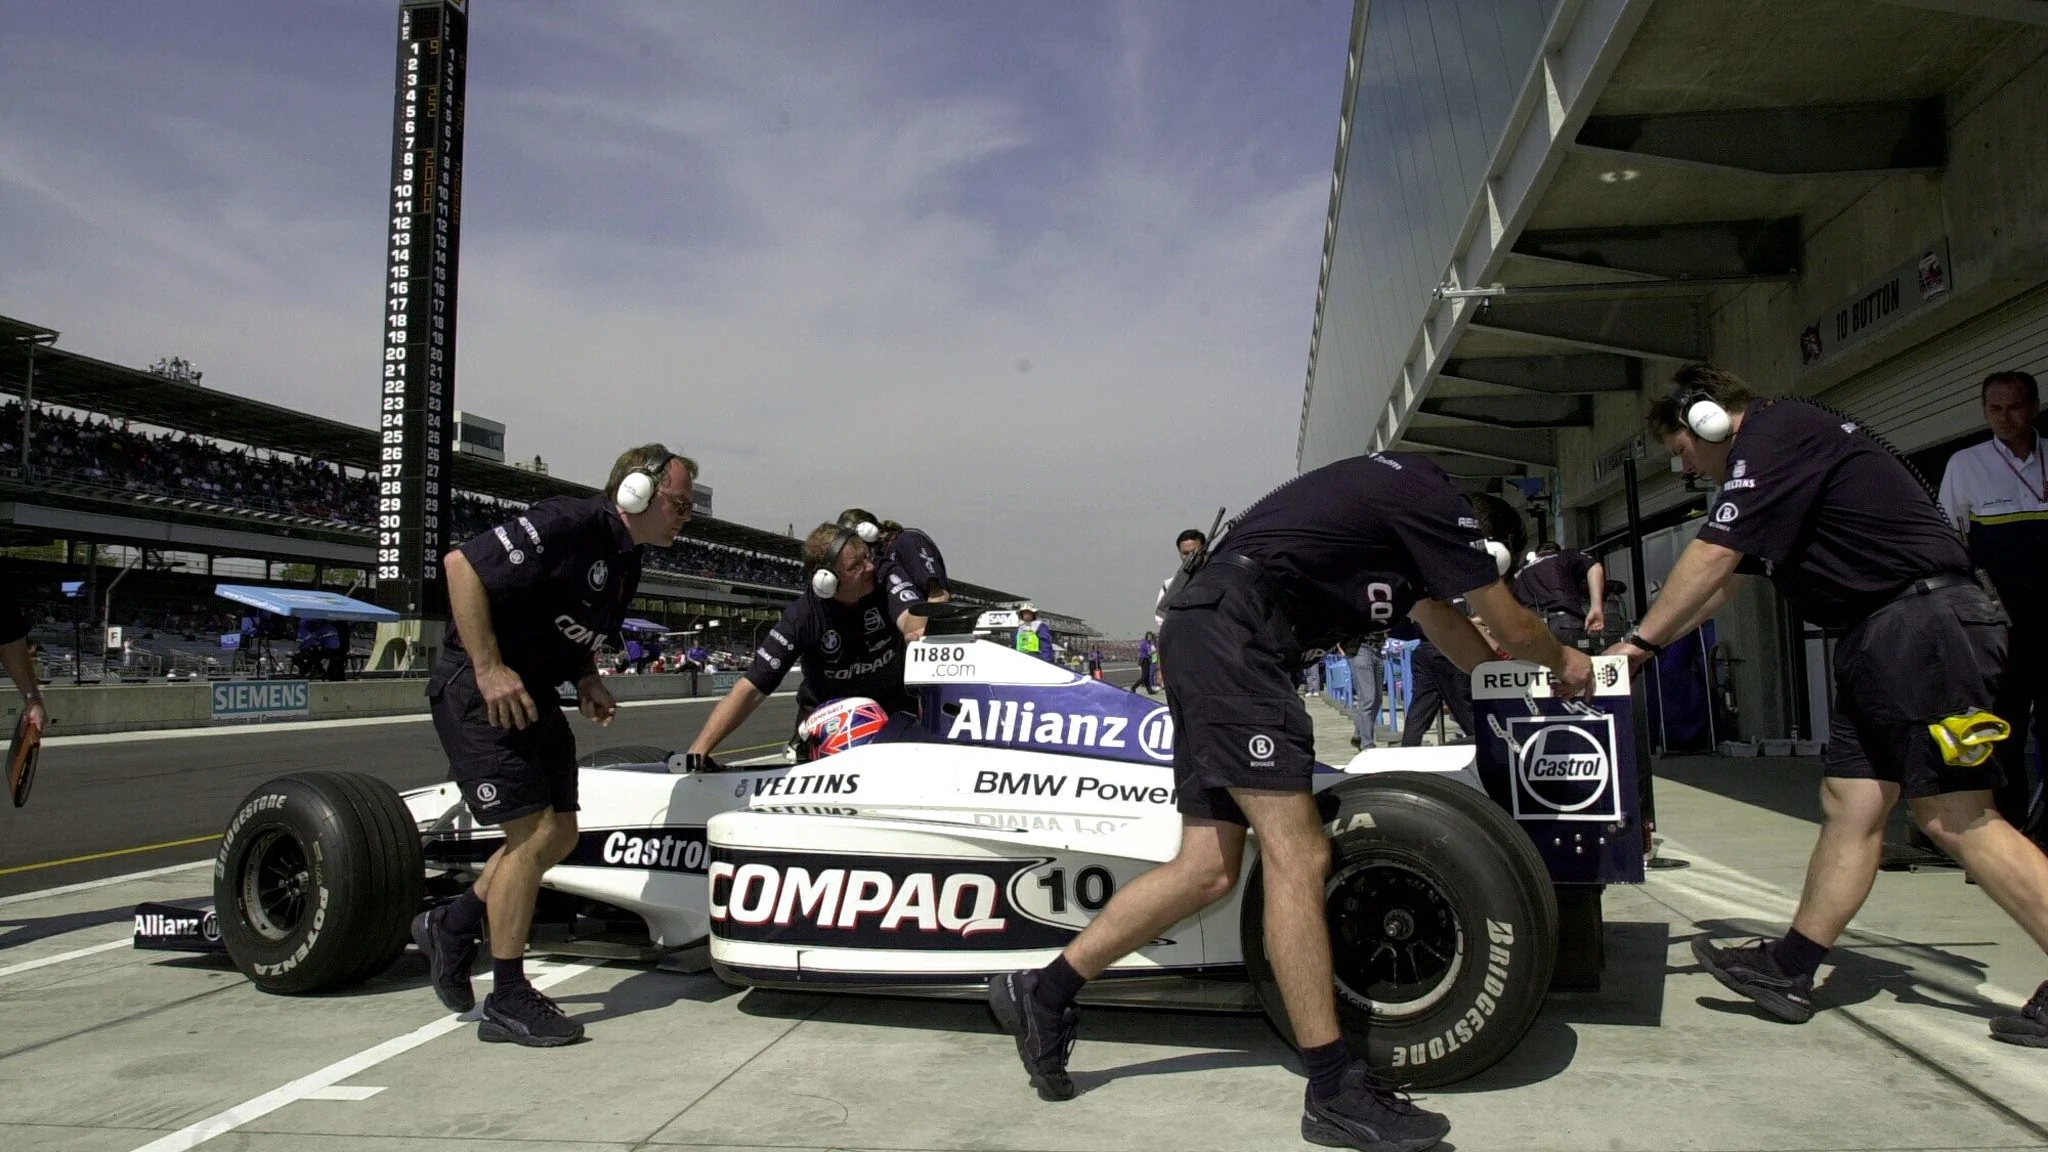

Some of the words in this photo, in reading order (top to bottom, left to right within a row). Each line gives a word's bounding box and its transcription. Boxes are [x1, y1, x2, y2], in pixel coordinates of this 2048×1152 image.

[410, 42, 419, 55] 1
[408, 58, 417, 70] 2
[408, 74, 417, 85] 3
[406, 90, 416, 101] 4
[406, 106, 415, 117] 5
[405, 121, 415, 133] 6
[405, 137, 414, 149] 7
[404, 153, 413, 165] 8
[404, 169, 413, 181] 9
[395, 185, 412, 197] 10
[395, 201, 411, 213] 11
[393, 217, 410, 229] 12
[392, 233, 410, 245] 13
[392, 249, 409, 261] 14
[391, 265, 408, 278] 15
[390, 282, 408, 294] 16
[390, 298, 407, 310] 17
[1836, 309, 1848, 342] 10
[1852, 277, 1900, 333] BUTTON
[389, 314, 407, 327] 18
[388, 331, 406, 343] 19
[386, 347, 405, 360] 20
[385, 364, 405, 377] 21
[385, 380, 404, 393] 22
[384, 397, 403, 410] 23
[383, 414, 403, 427] 24
[383, 431, 402, 443] 25
[383, 447, 402, 460] 26
[382, 464, 401, 477] 27
[381, 481, 401, 494] 28
[380, 498, 400, 511] 29
[380, 515, 400, 528] 30
[380, 532, 399, 545] 31
[379, 549, 399, 562] 32
[379, 566, 398, 579] 33
[110, 631, 118, 644] F
[913, 647, 965, 662] 11880
[824, 649, 896, 680] COMPAQ
[932, 663, 976, 677] .com
[215, 685, 306, 710] SIEMENS
[947, 699, 1128, 748] Allianz
[1534, 757, 1601, 777] Castrol
[754, 774, 860, 797] VELTINS
[974, 771, 1067, 797] BMW
[216, 794, 287, 881] BRIDGESTONE
[603, 831, 710, 869] Castrol
[1037, 864, 1116, 914] 10
[709, 861, 1008, 939] COMPAQ
[133, 914, 198, 937] Allianz
[253, 886, 329, 976] POTENZA
[1391, 917, 1514, 1067] BRIDGESTONE
